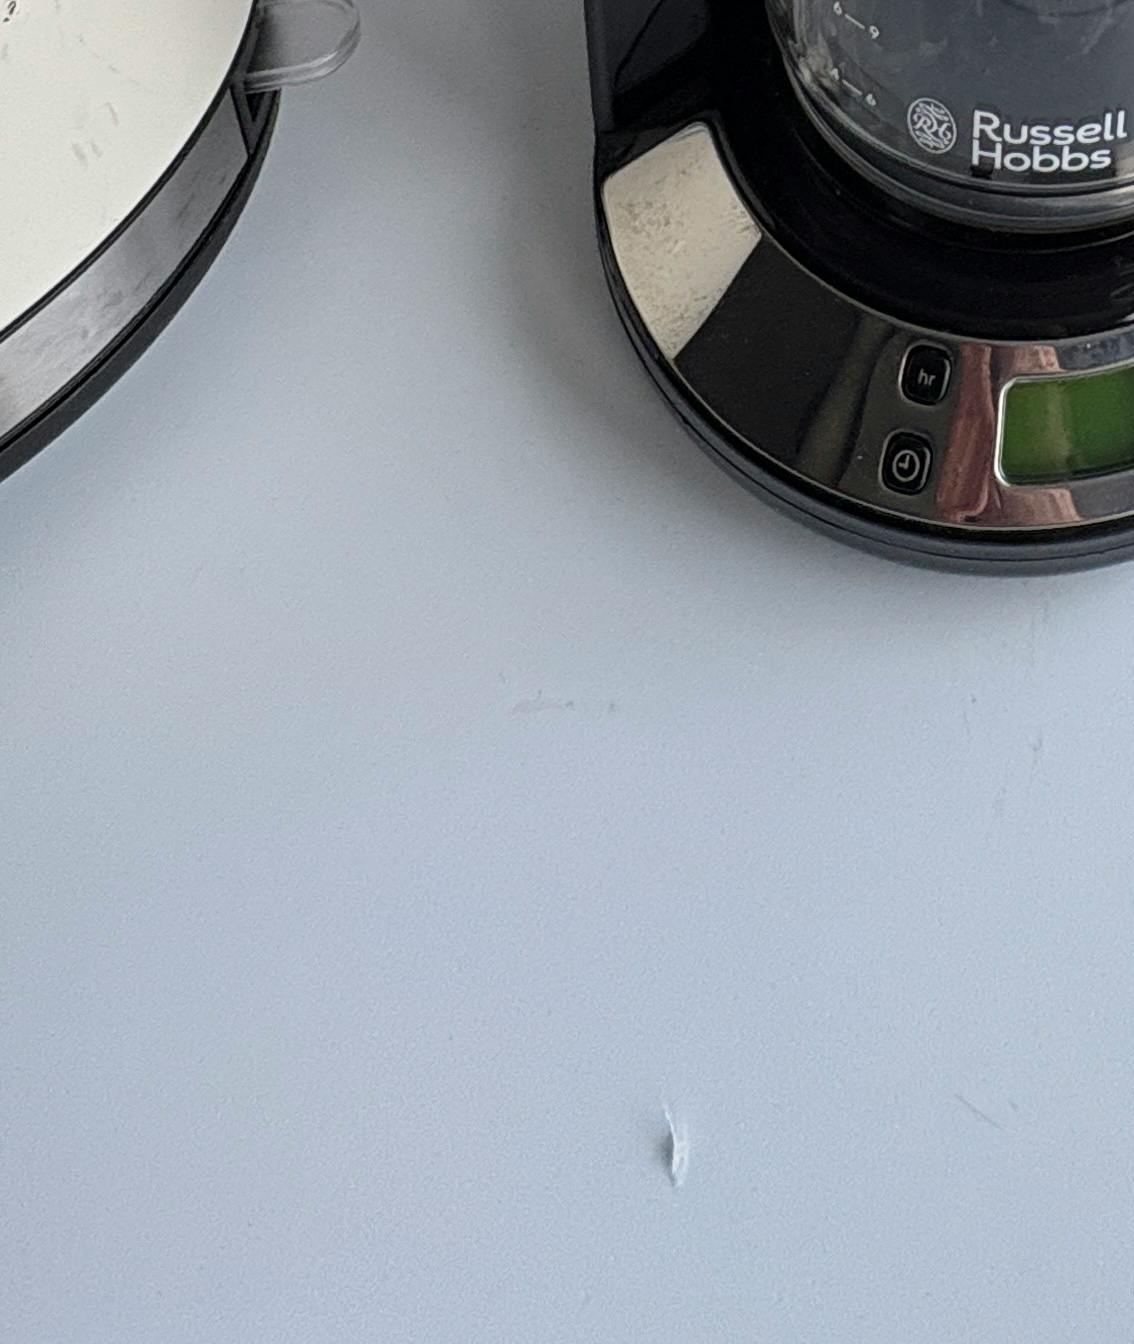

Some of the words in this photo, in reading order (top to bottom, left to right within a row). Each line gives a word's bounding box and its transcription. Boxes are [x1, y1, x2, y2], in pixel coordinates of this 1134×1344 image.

[869, 25, 880, 39] 9
[972, 109, 1128, 145] Russell
[971, 139, 1111, 172] Hobbs
[917, 368, 936, 386] hr
